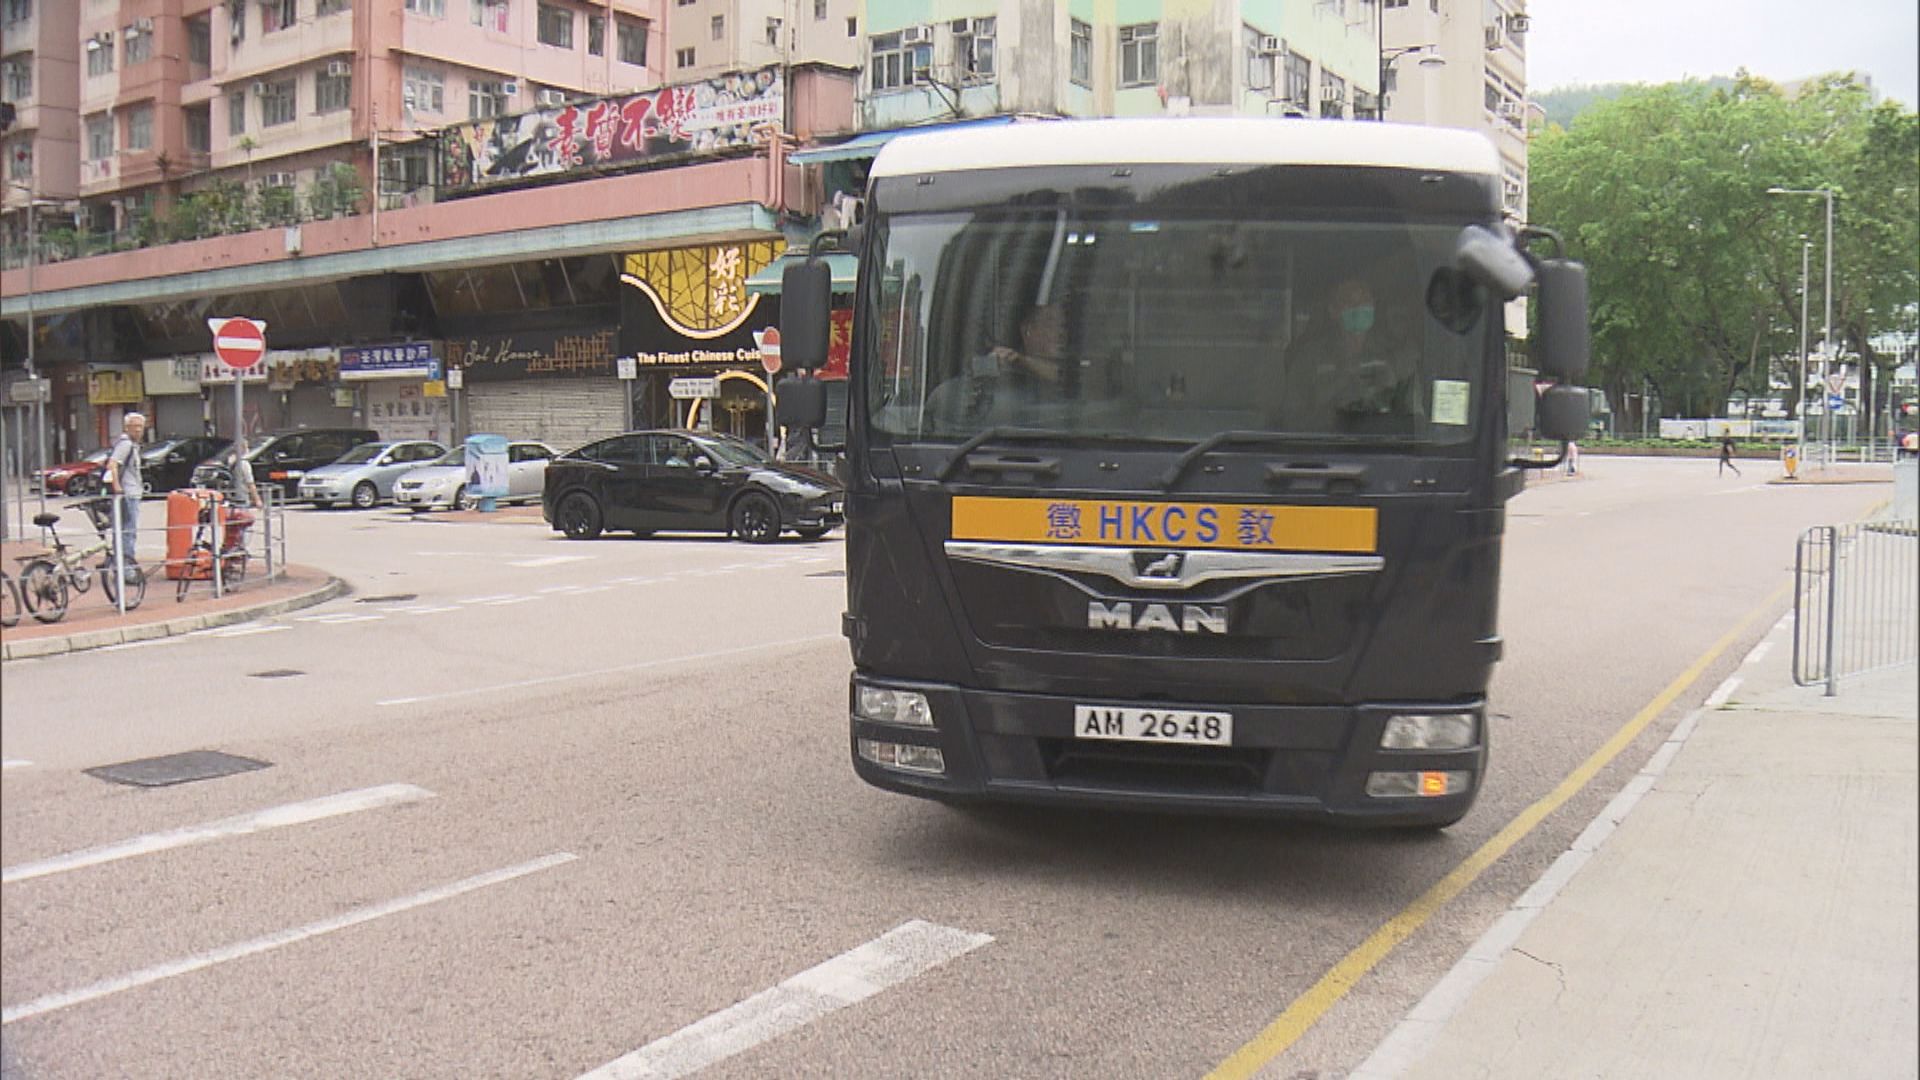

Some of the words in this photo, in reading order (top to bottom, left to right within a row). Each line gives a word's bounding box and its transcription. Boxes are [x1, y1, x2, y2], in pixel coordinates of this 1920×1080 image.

[710, 247, 740, 315] 好彩
[637, 352, 656, 364] The
[658, 351, 690, 363] Finest
[691, 350, 735, 363] Chinese
[736, 347, 761, 361] Cuis
[1046, 503, 1081, 540] 懲
[1099, 505, 1219, 543] HKCS
[1088, 601, 1227, 634] MAN
[1084, 710, 1123, 735] AM
[1139, 712, 1222, 740] 2648
